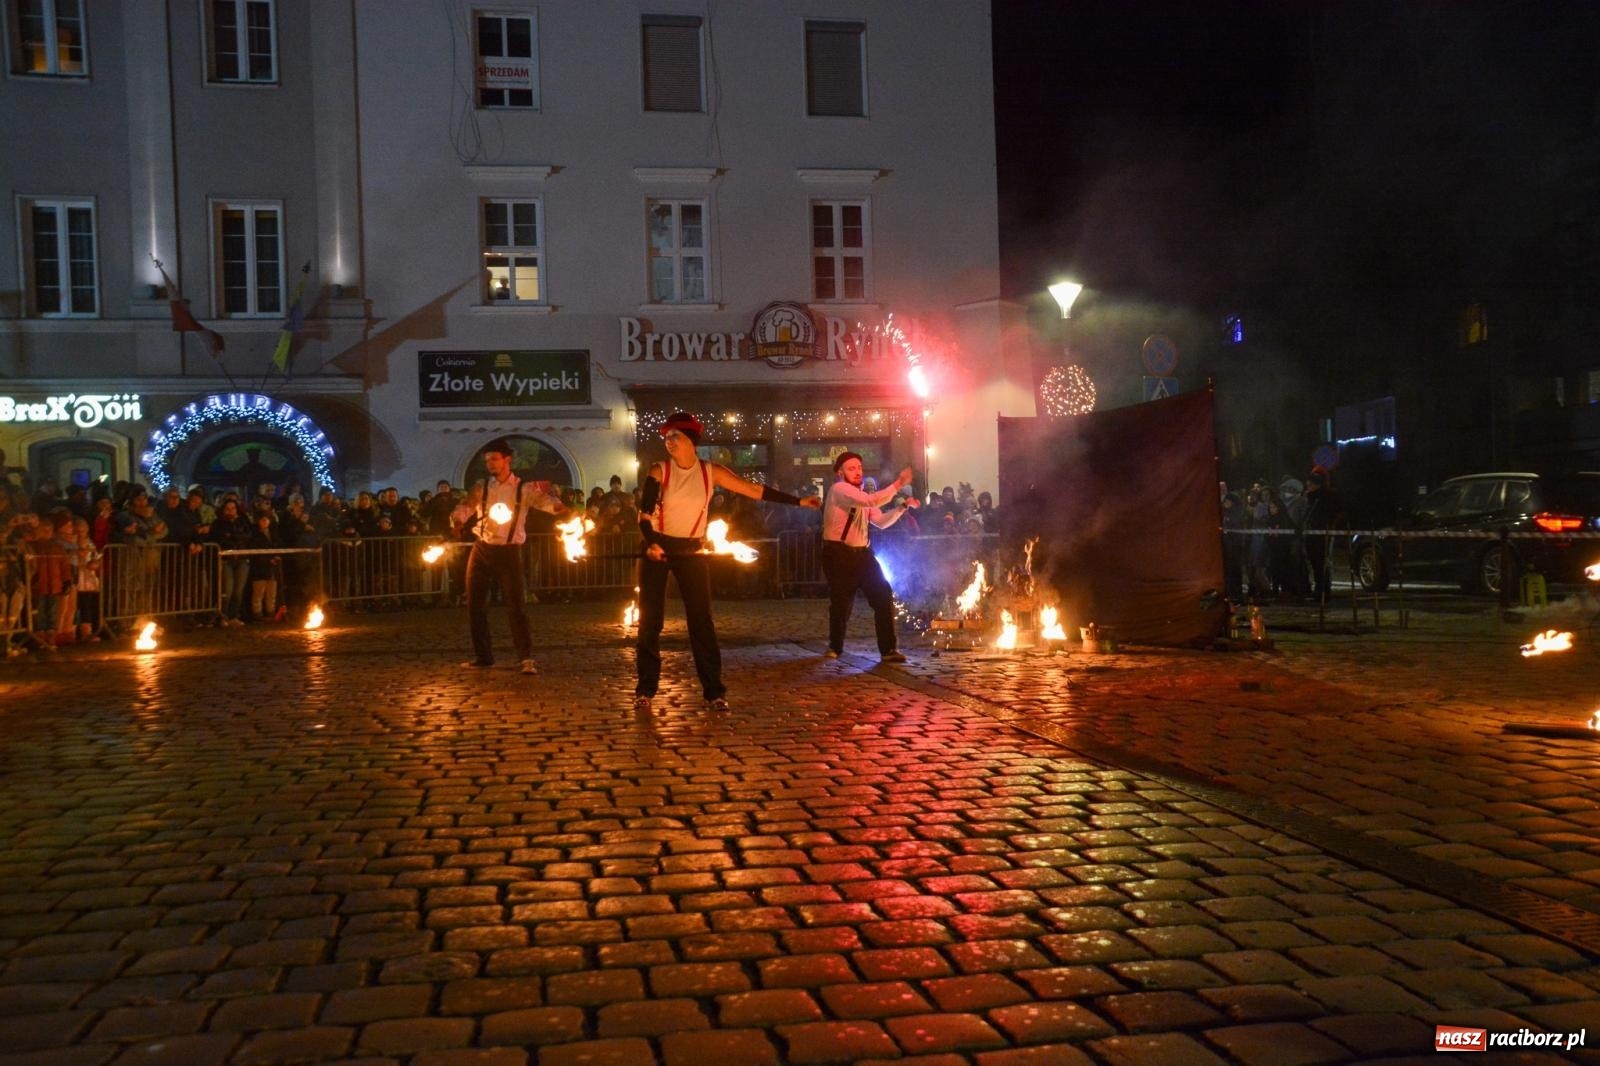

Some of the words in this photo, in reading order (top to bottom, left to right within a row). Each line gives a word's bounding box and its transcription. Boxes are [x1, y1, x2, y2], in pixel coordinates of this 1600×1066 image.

[478, 66, 529, 78] SPRZEDAM
[618, 316, 744, 362] Browar
[429, 372, 484, 392] Złote
[490, 369, 580, 396] Wypieki
